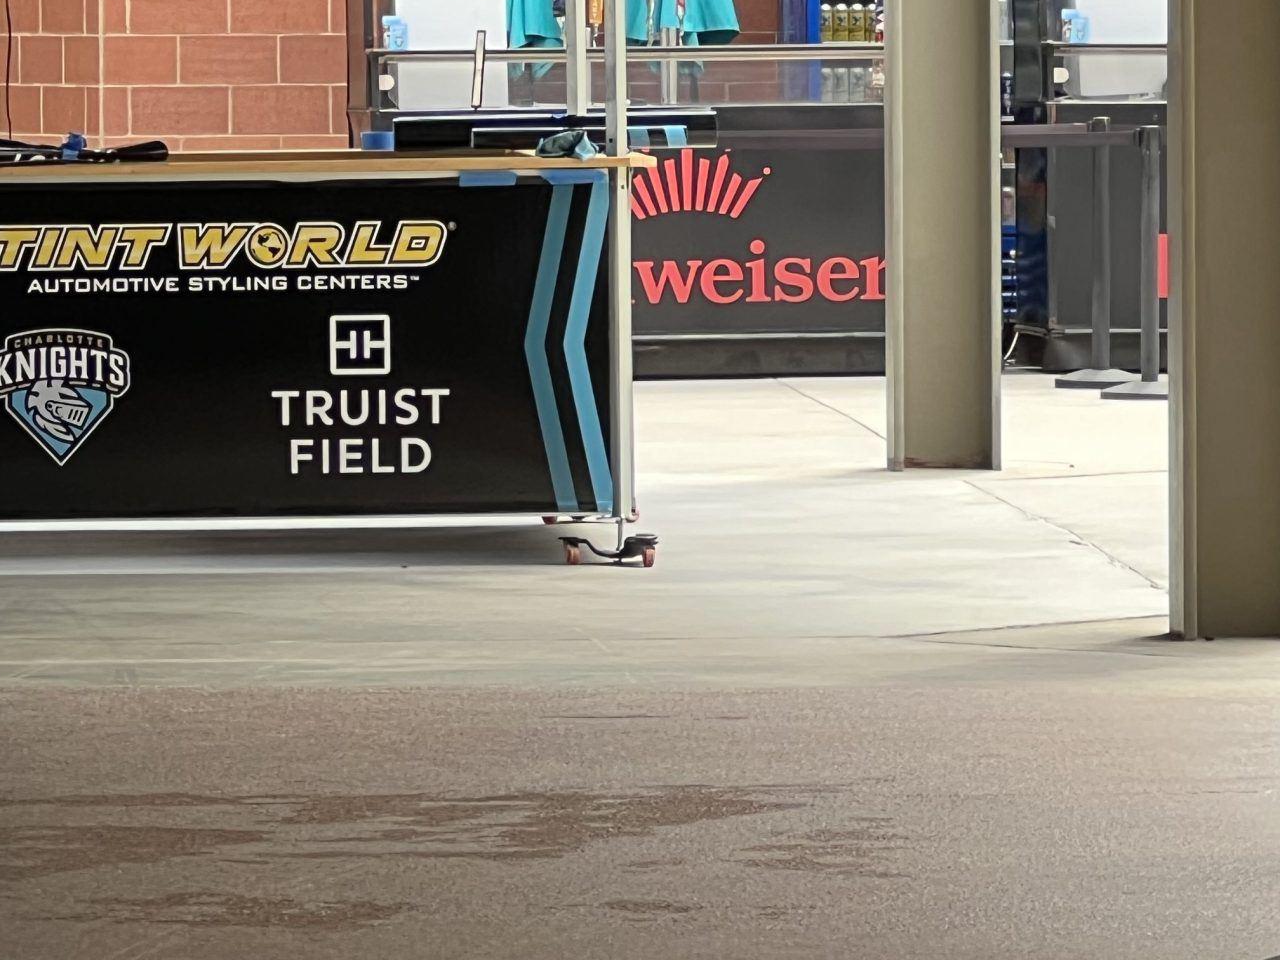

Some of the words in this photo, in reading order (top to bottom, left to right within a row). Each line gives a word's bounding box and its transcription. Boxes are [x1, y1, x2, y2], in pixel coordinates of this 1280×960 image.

[27, 277, 180, 294] AUTOMOTIVE
[187, 275, 288, 292] STYLING
[14, 335, 103, 349] CHARLOTTE
[271, 388, 451, 426] TRUIST
[290, 437, 432, 475] FIELD
